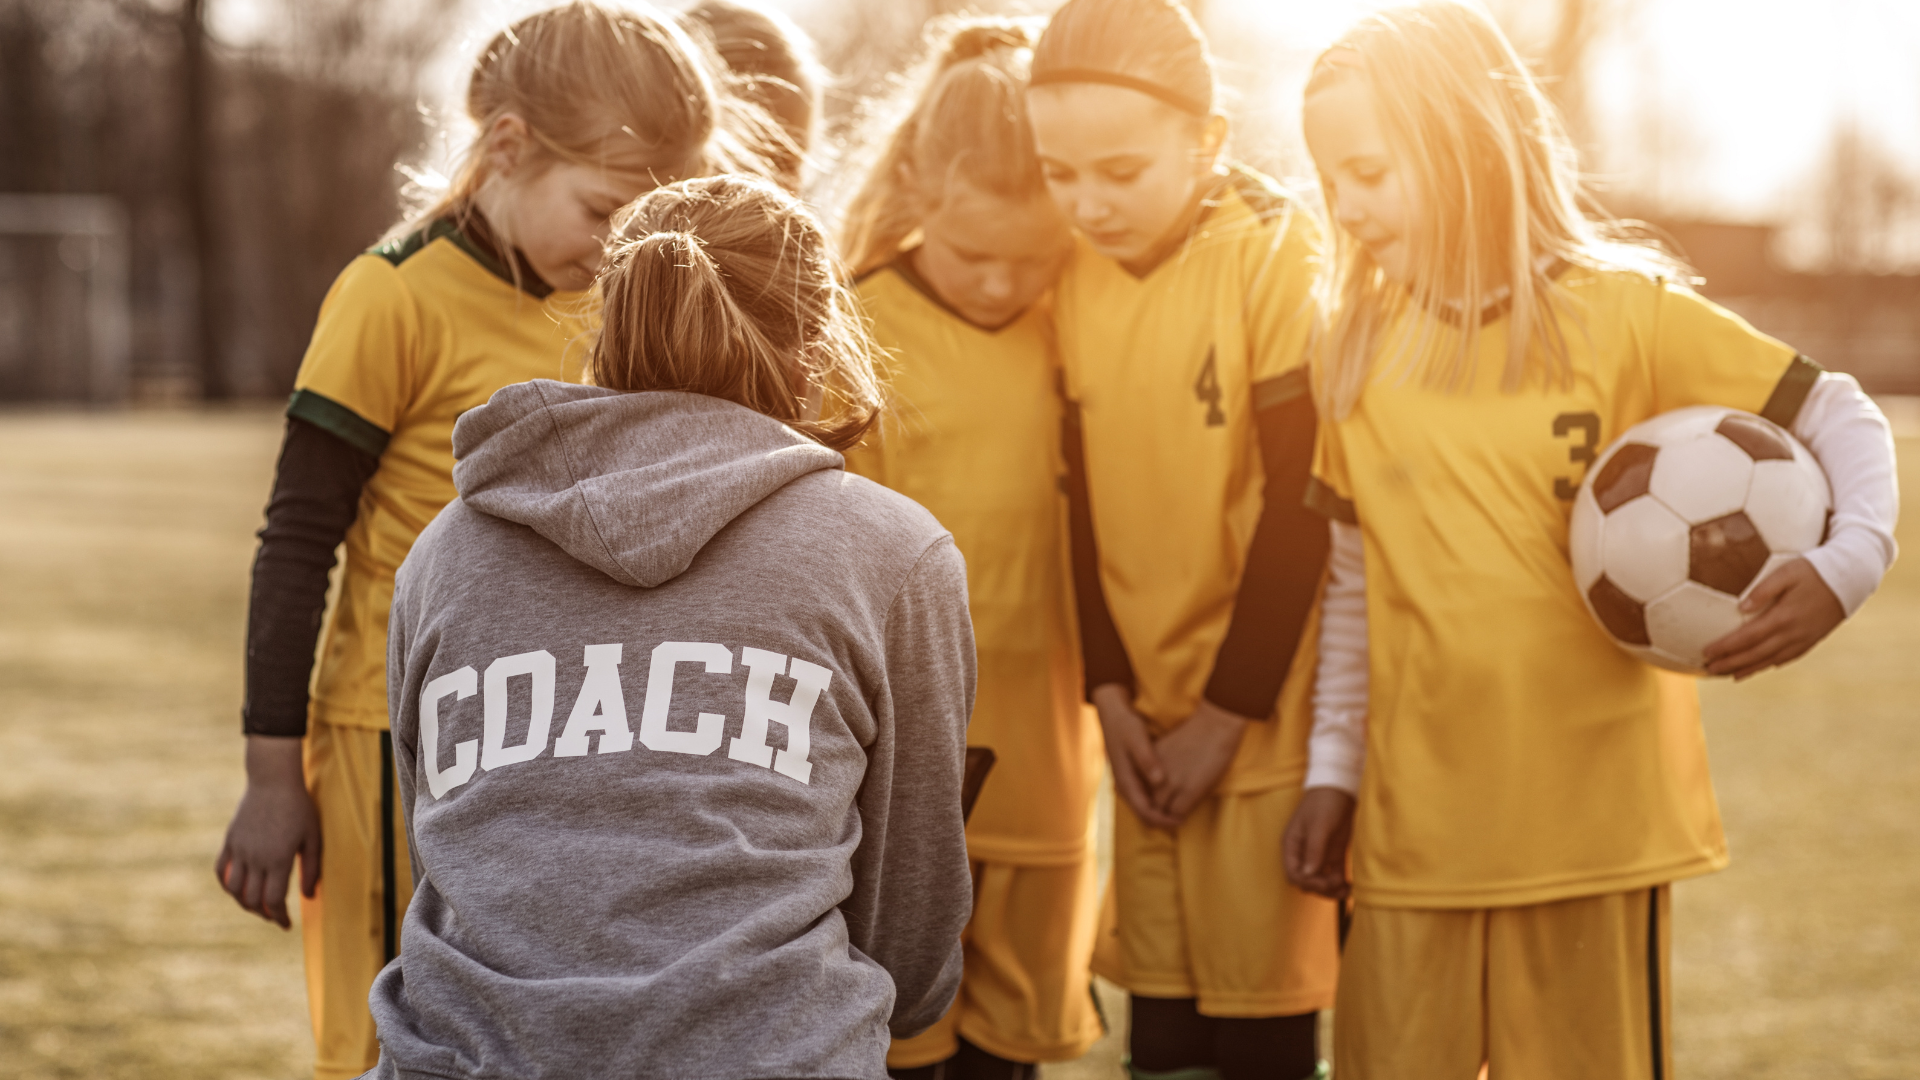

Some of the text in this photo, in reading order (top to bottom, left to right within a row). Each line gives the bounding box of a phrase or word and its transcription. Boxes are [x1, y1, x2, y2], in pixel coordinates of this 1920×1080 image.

[1193, 342, 1226, 428] 4
[1552, 411, 1601, 501] 3
[419, 641, 833, 800] COACH
